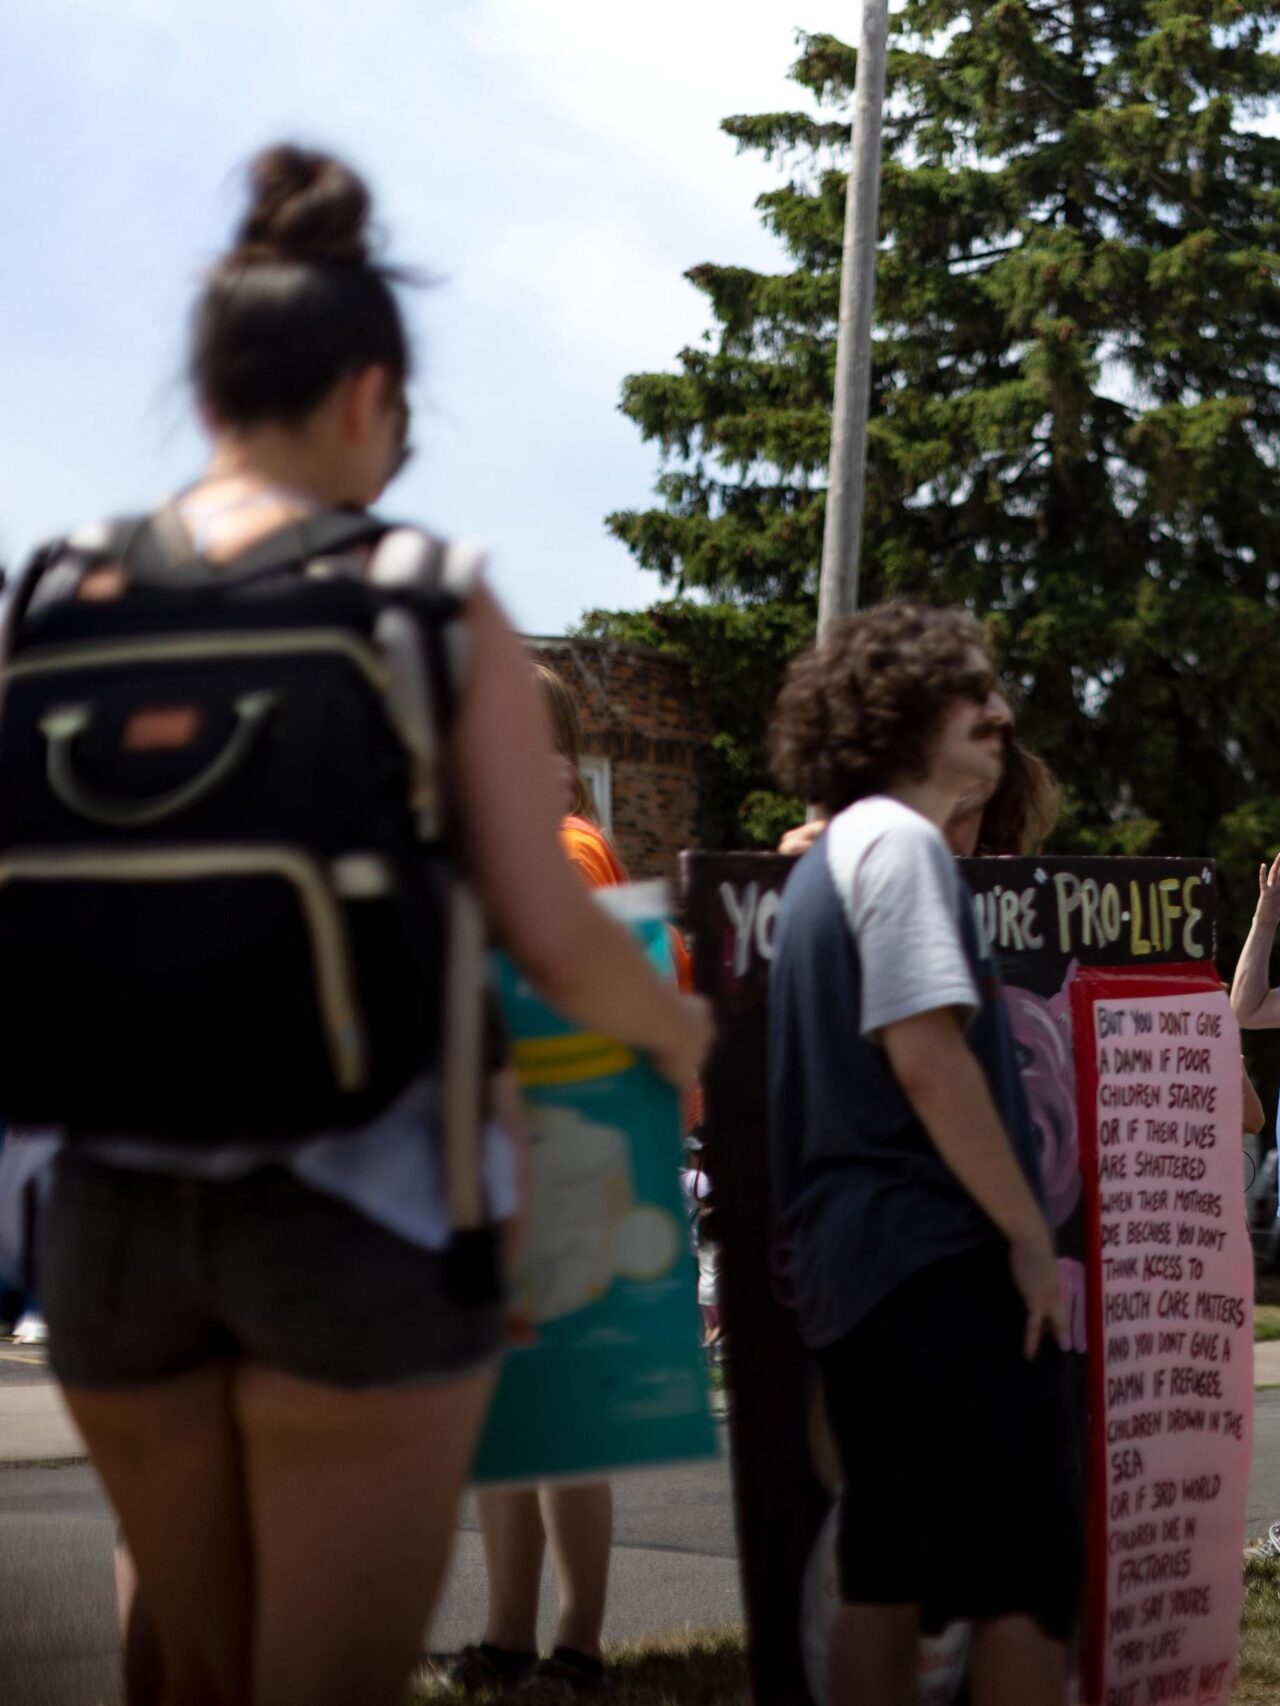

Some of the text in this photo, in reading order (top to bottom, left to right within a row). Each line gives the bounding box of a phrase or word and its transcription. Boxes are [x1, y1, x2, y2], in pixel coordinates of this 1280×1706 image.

[1097, 1007, 1125, 1038] BUT
[1130, 1009, 1152, 1035] YOU
[1196, 1011, 1222, 1038] GIVE
[1100, 1046, 1211, 1074] A DAMN IF POOR
[1100, 1083, 1218, 1113] CHILDREN STARVE
[1100, 1117, 1216, 1149] OR IF THEIR LIVES
[1100, 1151, 1206, 1182] ARE SHATTERED
[1099, 1190, 1133, 1214] WHEN
[1174, 1189, 1222, 1217] MOTHERS
[1100, 1222, 1120, 1248] DIE
[1126, 1221, 1172, 1245] BECAUSE
[1177, 1222, 1196, 1247] YOU
[1102, 1254, 1203, 1282] THINK ACCESS TO
[1105, 1289, 1244, 1329] HEALTH CARE MATTERS
[1107, 1335, 1129, 1366] AND
[1134, 1331, 1154, 1360] YOU
[1190, 1331, 1219, 1362] GIVE
[1222, 1336, 1231, 1364] A
[1107, 1366, 1222, 1409] DAMN IF REFUGEE
[1106, 1408, 1243, 1444] CHILDREN DROWN IN THE
[1111, 1448, 1144, 1484] SEA
[1110, 1474, 1221, 1521] OR IF 3RD WORLD
[1108, 1516, 1196, 1556] CHILDREN DIE IN
[1117, 1548, 1192, 1597] FACTORIES
